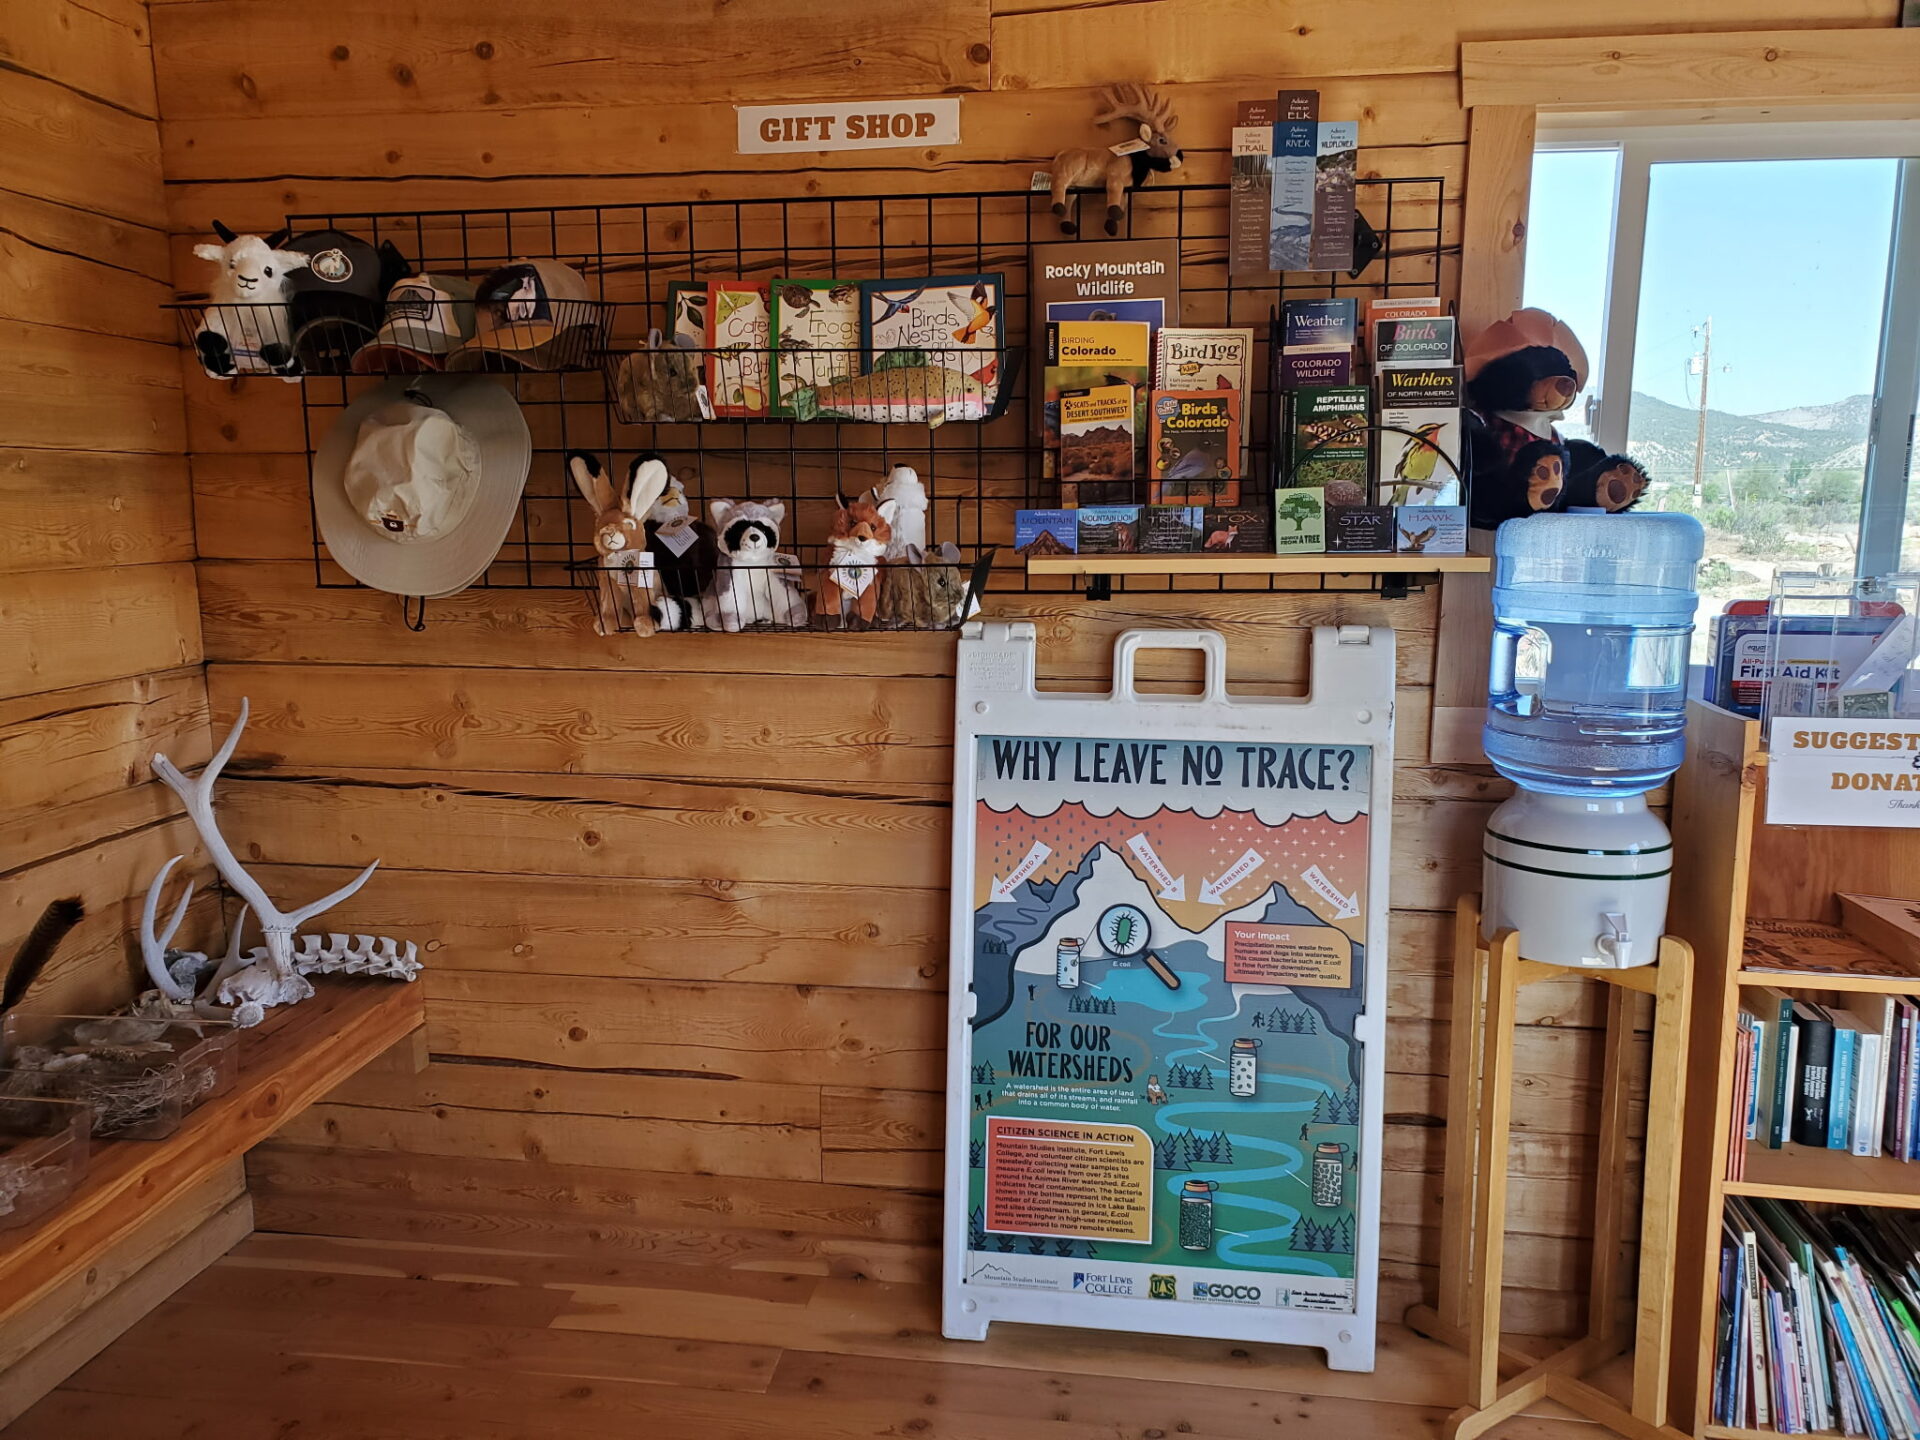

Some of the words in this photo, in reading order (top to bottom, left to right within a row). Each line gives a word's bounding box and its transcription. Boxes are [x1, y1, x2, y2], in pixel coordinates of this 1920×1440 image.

[1288, 112, 1312, 120] ELK
[760, 116, 836, 143] GIFT
[846, 113, 936, 140] SHOP
[1285, 140, 1310, 148] RIVER
[1321, 140, 1354, 148] WILDFLOWER
[1045, 264, 1091, 279] Rocky
[1095, 260, 1165, 278] Mountain
[1076, 280, 1134, 296] Wildlife
[912, 307, 960, 328] Birds,
[1385, 310, 1427, 318] COLORADO
[1295, 315, 1346, 327] Weather
[898, 324, 948, 347] Nests
[1393, 322, 1437, 340] Birds
[1062, 346, 1116, 355] Colorado
[1380, 344, 1393, 352] OF
[1395, 342, 1448, 351] COLORADO
[1292, 359, 1341, 368] COLORADO
[1296, 369, 1336, 377] WILDLIFE
[1392, 372, 1453, 387] Warblers
[1067, 409, 1089, 418] DESERT
[1091, 406, 1128, 416] SOUTHWEST
[1182, 403, 1218, 415] Birds
[1312, 404, 1365, 412] AMPHIBIANS
[1167, 415, 1230, 428] Colorado
[1338, 516, 1382, 526] STAR
[1408, 514, 1455, 522] HAWK
[1299, 536, 1304, 544] A
[1304, 535, 1320, 543] TREE
[1782, 666, 1811, 678] Aid
[1793, 731, 1920, 750] SUGGEST
[992, 740, 1061, 781] WHY
[1074, 742, 1167, 785] LEAVE
[1236, 747, 1355, 792] TRACE?
[1139, 846, 1172, 887] WATERSHED
[998, 859, 1035, 894] WATERSHED
[1209, 862, 1249, 896] WATERSHED
[1309, 872, 1349, 910] WATERSHED
[1234, 931, 1256, 939] Your
[1258, 932, 1290, 941] Impact
[1234, 941, 1274, 949] Precipitation
[1025, 1022, 1061, 1049] FOR
[1070, 1024, 1111, 1052] OUR
[1008, 1050, 1133, 1083] WATERSHEDS
[1017, 1090, 1038, 1098] drains
[1114, 1097, 1138, 1105] rainfall
[1071, 1102, 1089, 1110] body
[997, 1127, 1035, 1136] CITIZEN
[1038, 1128, 1080, 1138] SCIENCE
[1096, 1133, 1134, 1142] ACTION
[1057, 1146, 1087, 1154] Institute,
[996, 1150, 1024, 1158] College,
[1100, 1157, 1131, 1165] scientists
[996, 1158, 1032, 1166] repeatedly
[1013, 1275, 1033, 1283] Studies
[1035, 1277, 1058, 1285] Institute
[1086, 1273, 1107, 1282] FORT
[1110, 1274, 1133, 1284] LEWIS
[1085, 1283, 1133, 1295] COLLEGE
[1209, 1283, 1261, 1301] GOCO
